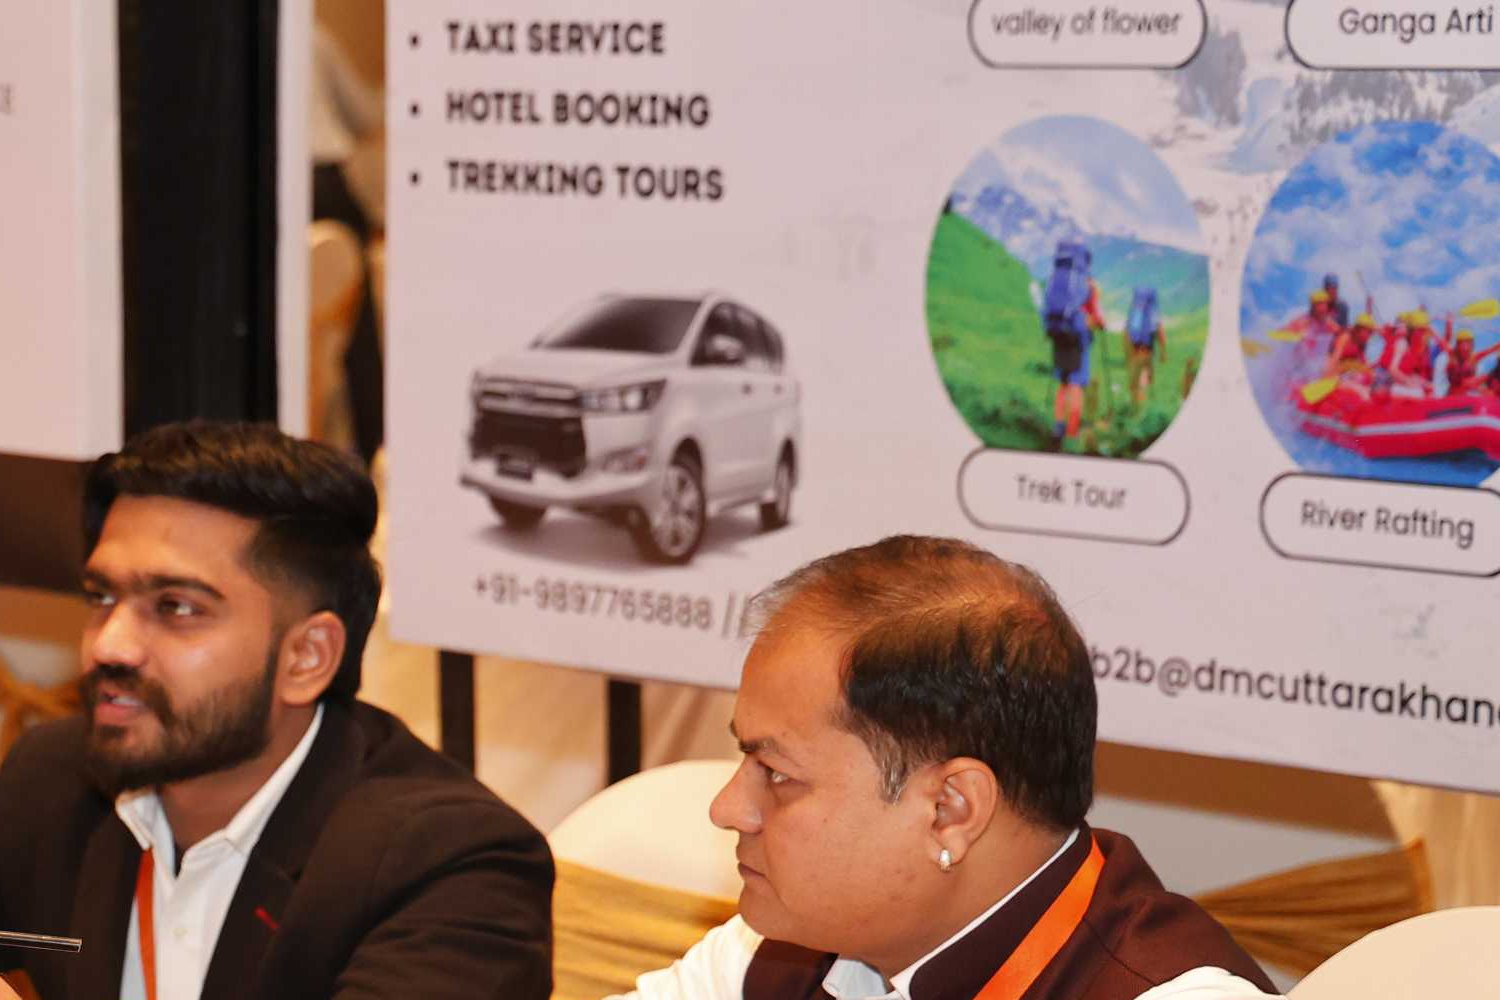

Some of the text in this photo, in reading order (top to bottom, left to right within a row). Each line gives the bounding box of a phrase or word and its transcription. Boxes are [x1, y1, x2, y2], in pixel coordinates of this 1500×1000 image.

[446, 22, 666, 54] TAXI SERVICE
[991, 5, 1184, 41] valley of flower
[1338, 8, 1495, 43] Ganga Arti
[445, 93, 711, 128] HOTEL BOOKING
[447, 160, 724, 201] TREKKING TOURS
[1016, 474, 1127, 509] Trek Tour
[1302, 499, 1475, 550] River Rafting
[1090, 645, 1500, 731] b2b@dmcuttarakhan
